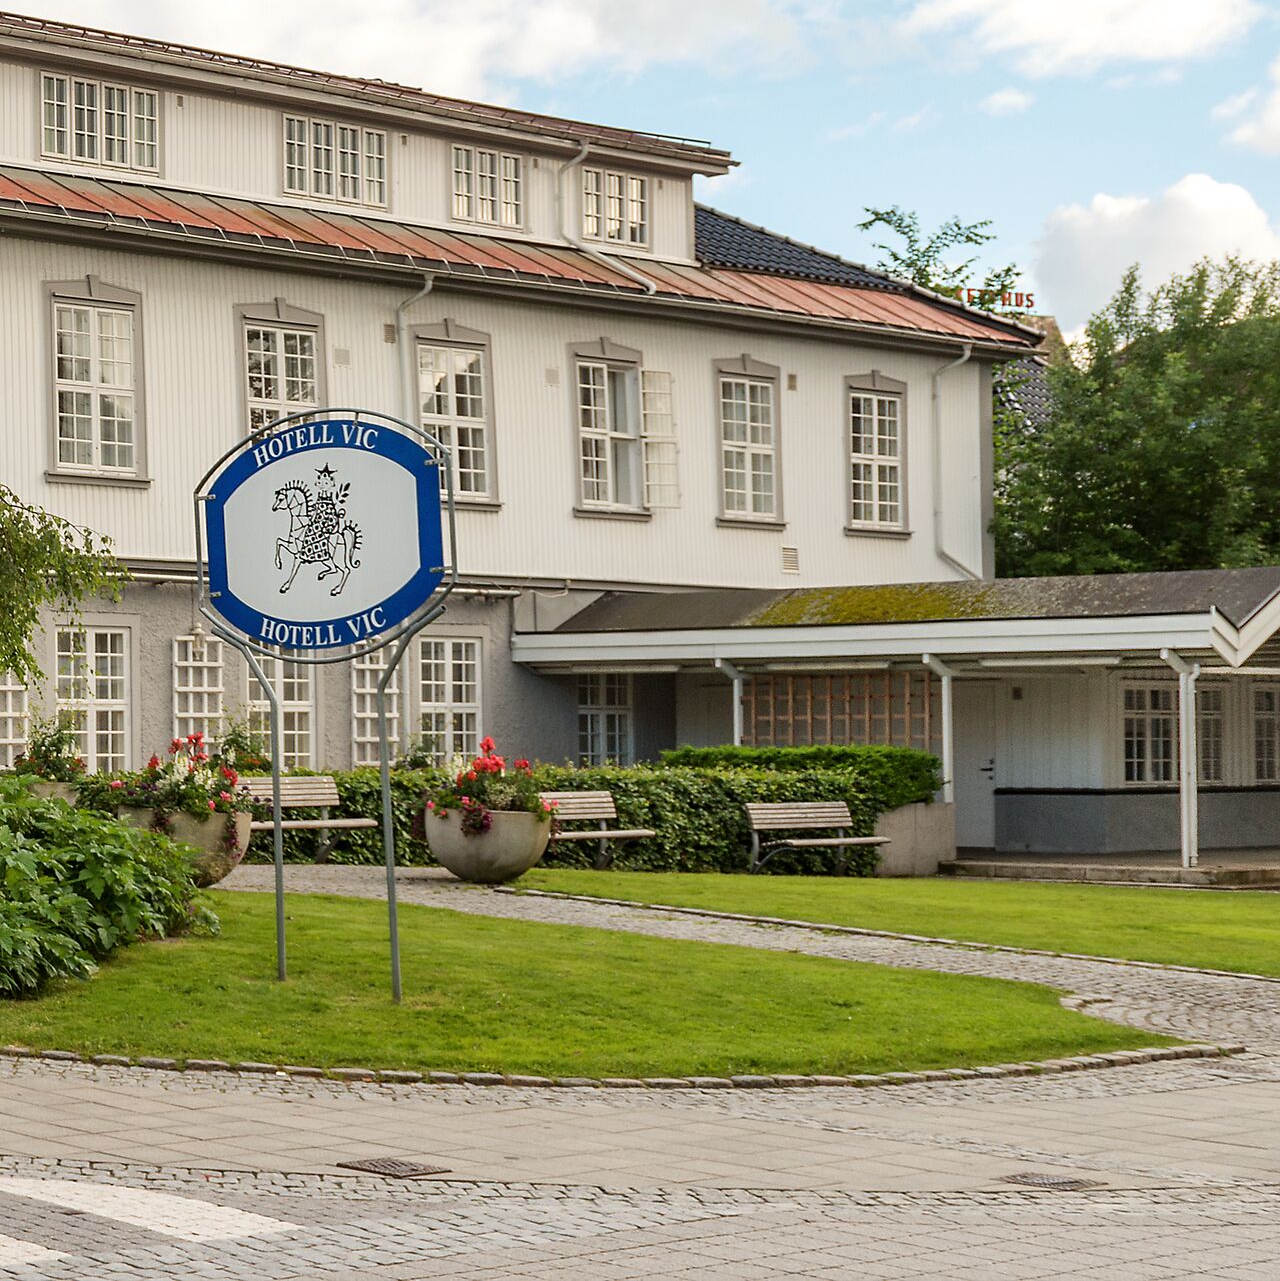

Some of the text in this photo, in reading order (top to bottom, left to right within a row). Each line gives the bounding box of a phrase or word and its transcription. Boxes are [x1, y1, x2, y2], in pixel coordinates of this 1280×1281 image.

[252, 423, 379, 468] HOTELL VIC
[260, 607, 387, 647] HOTELL VIC
